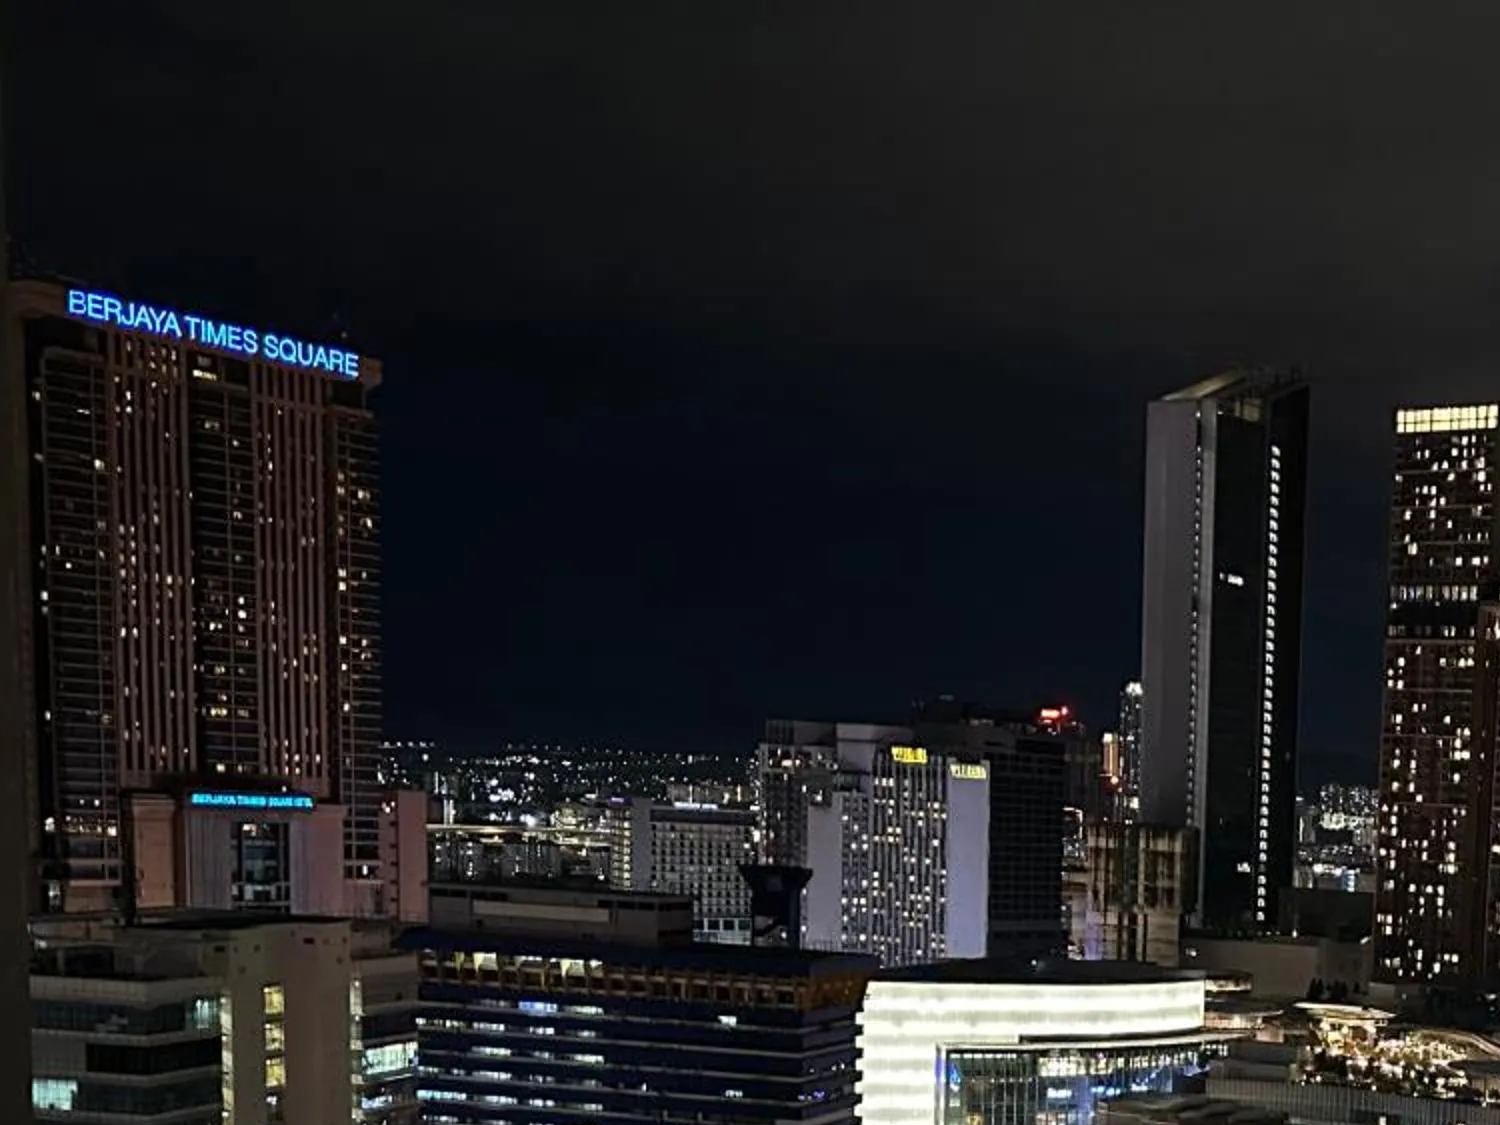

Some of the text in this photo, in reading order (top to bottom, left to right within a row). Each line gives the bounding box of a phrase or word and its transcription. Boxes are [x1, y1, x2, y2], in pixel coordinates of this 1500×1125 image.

[68, 290, 359, 377] BERJAYA TIMES SQUARE
